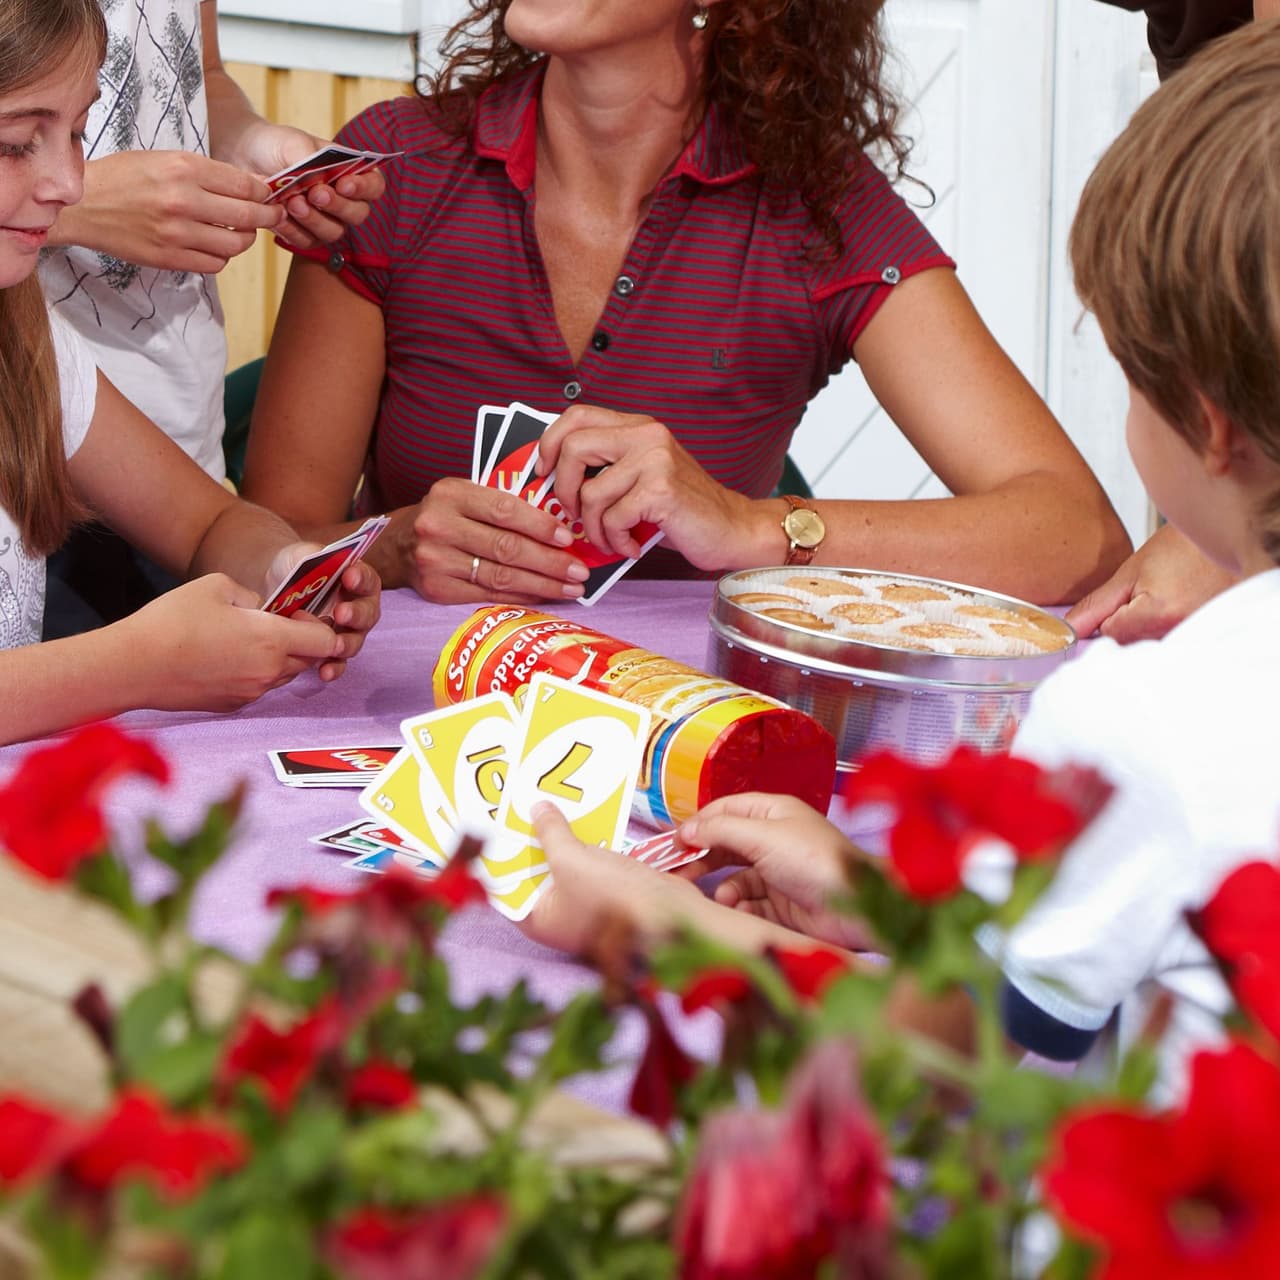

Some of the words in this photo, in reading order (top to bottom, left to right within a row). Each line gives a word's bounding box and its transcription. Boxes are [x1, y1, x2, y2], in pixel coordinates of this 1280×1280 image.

[270, 575, 328, 613] UNO
[448, 609, 526, 691] Sondey
[490, 622, 582, 693] oppelkeks
[513, 635, 558, 682] Rolle
[542, 686, 556, 703] 7
[418, 727, 434, 749] 6
[330, 749, 388, 771] UNO
[537, 741, 592, 803] 7
[376, 793, 396, 812] 5
